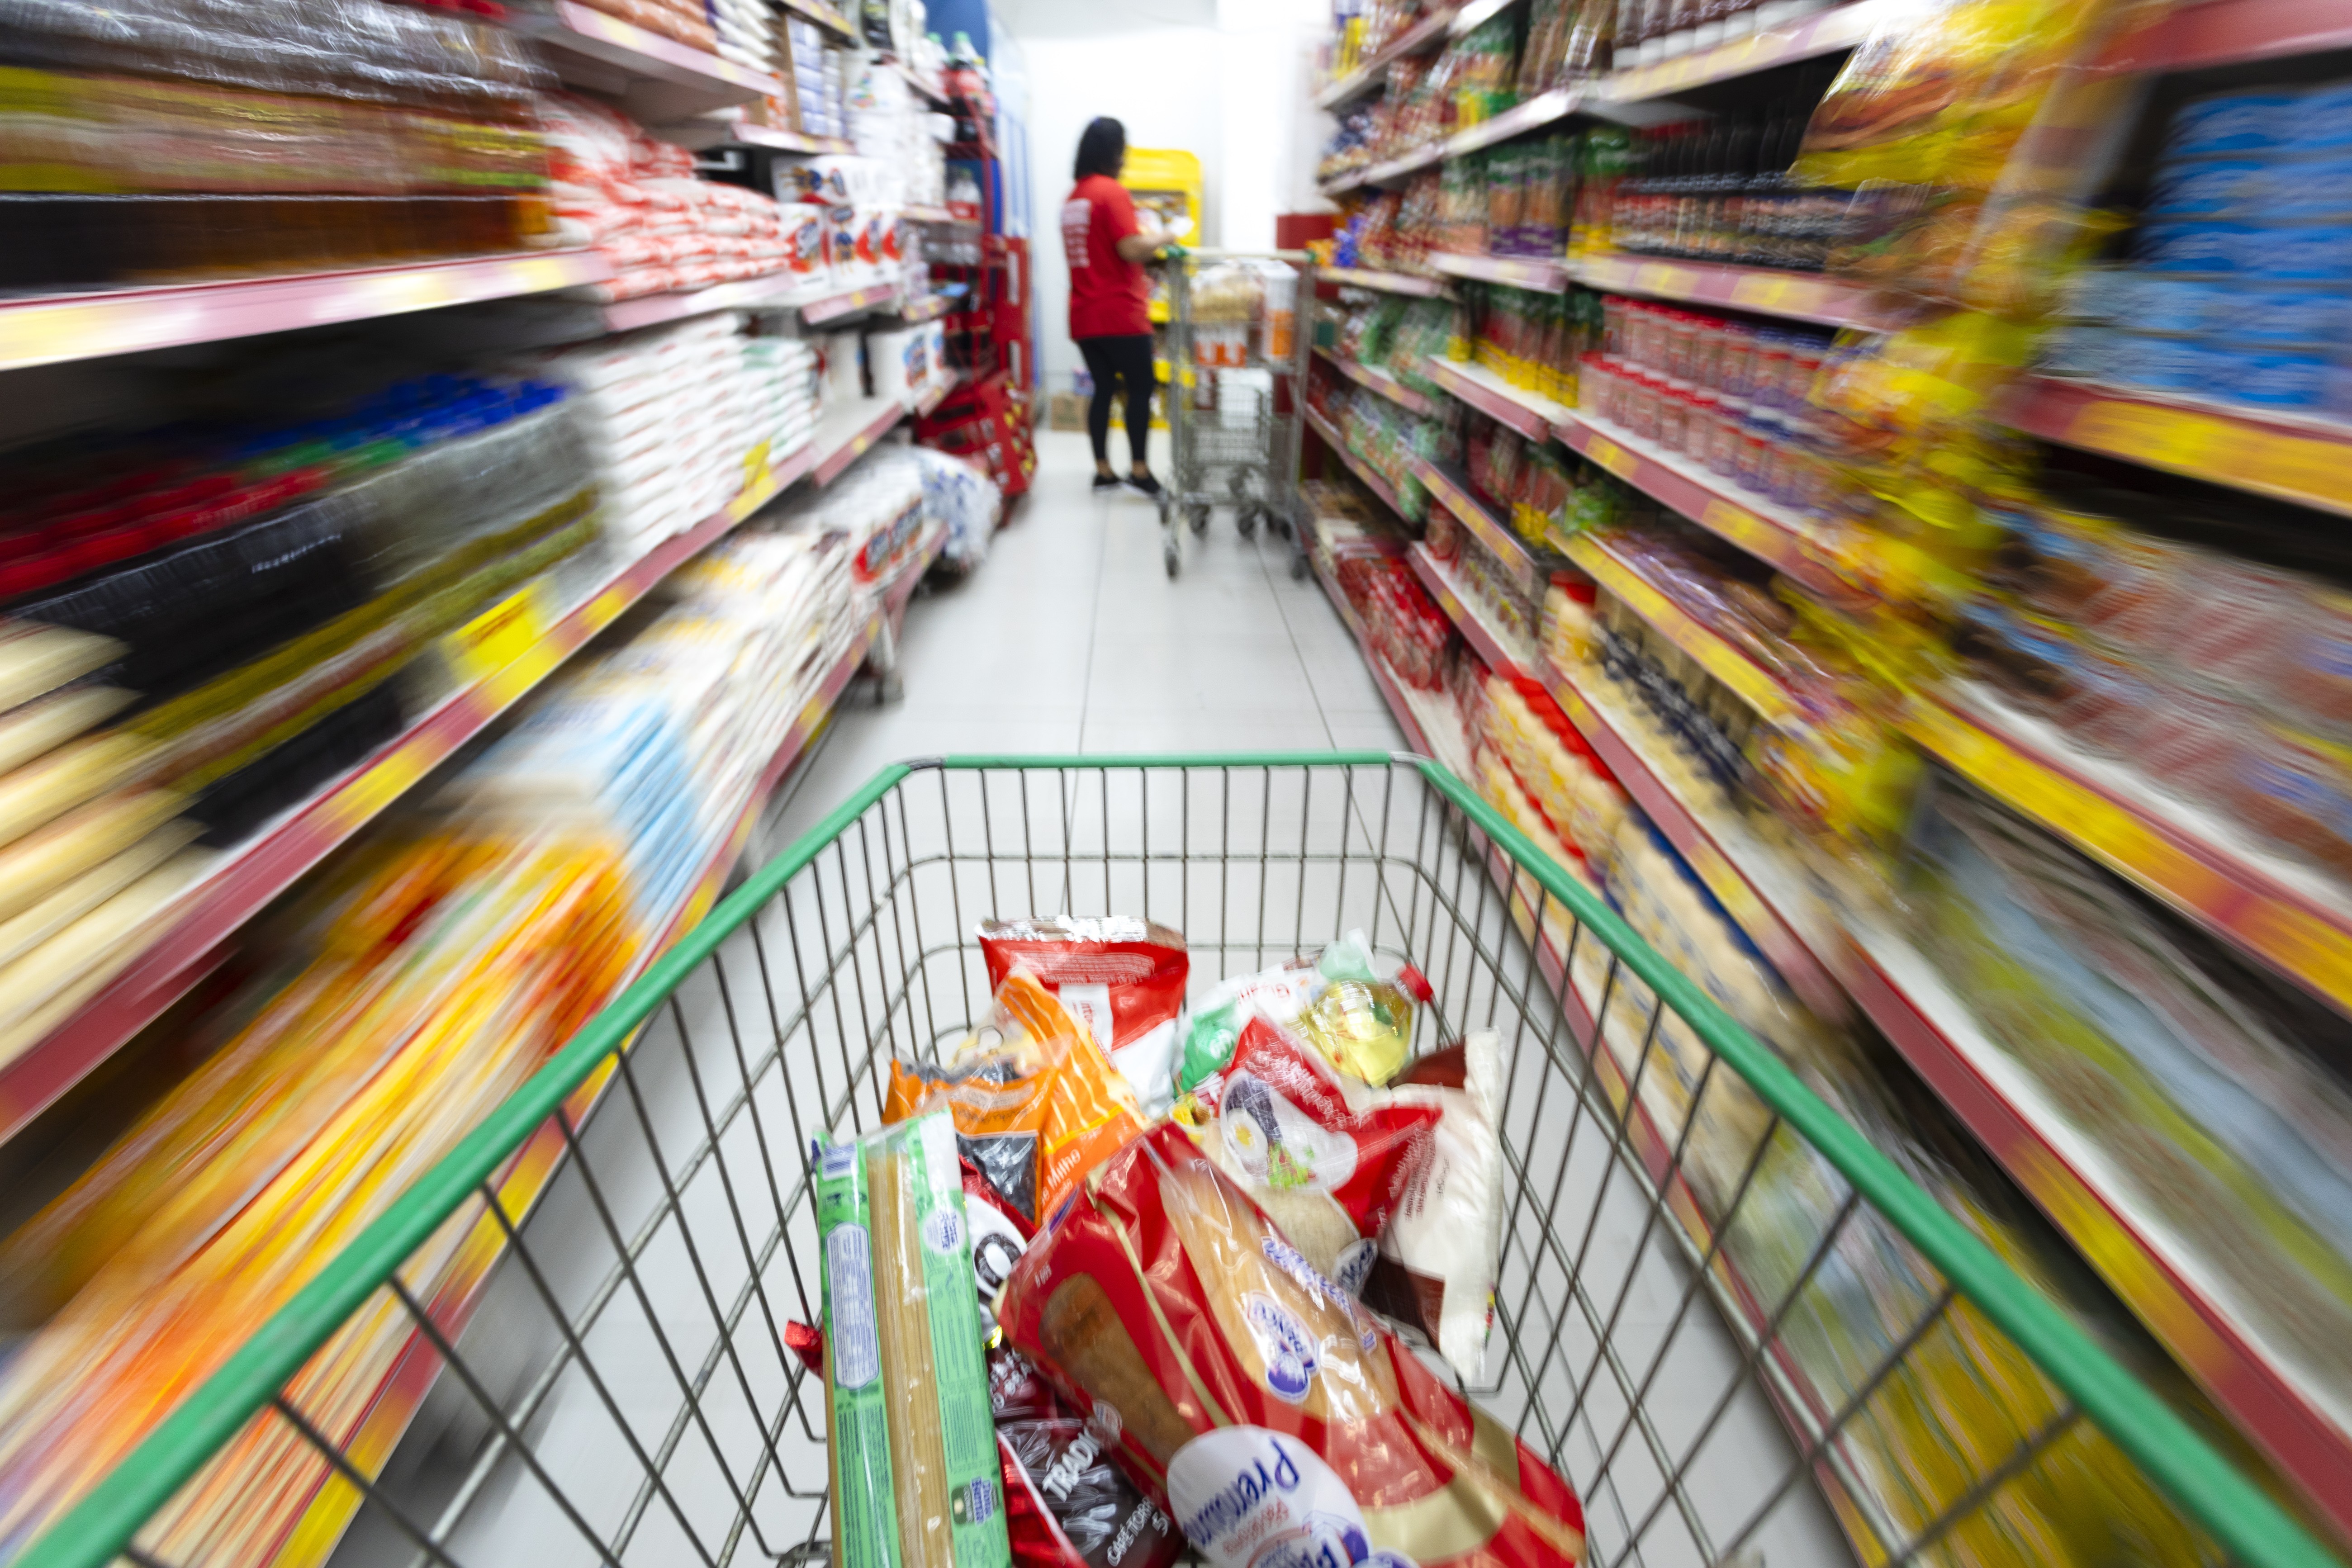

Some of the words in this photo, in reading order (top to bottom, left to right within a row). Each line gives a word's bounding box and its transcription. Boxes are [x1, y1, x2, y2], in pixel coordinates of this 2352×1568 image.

[1045, 1149, 1080, 1191] Milho
[1107, 1523, 1134, 1566] CAFÉ
[1124, 1495, 1154, 1537] TORR
